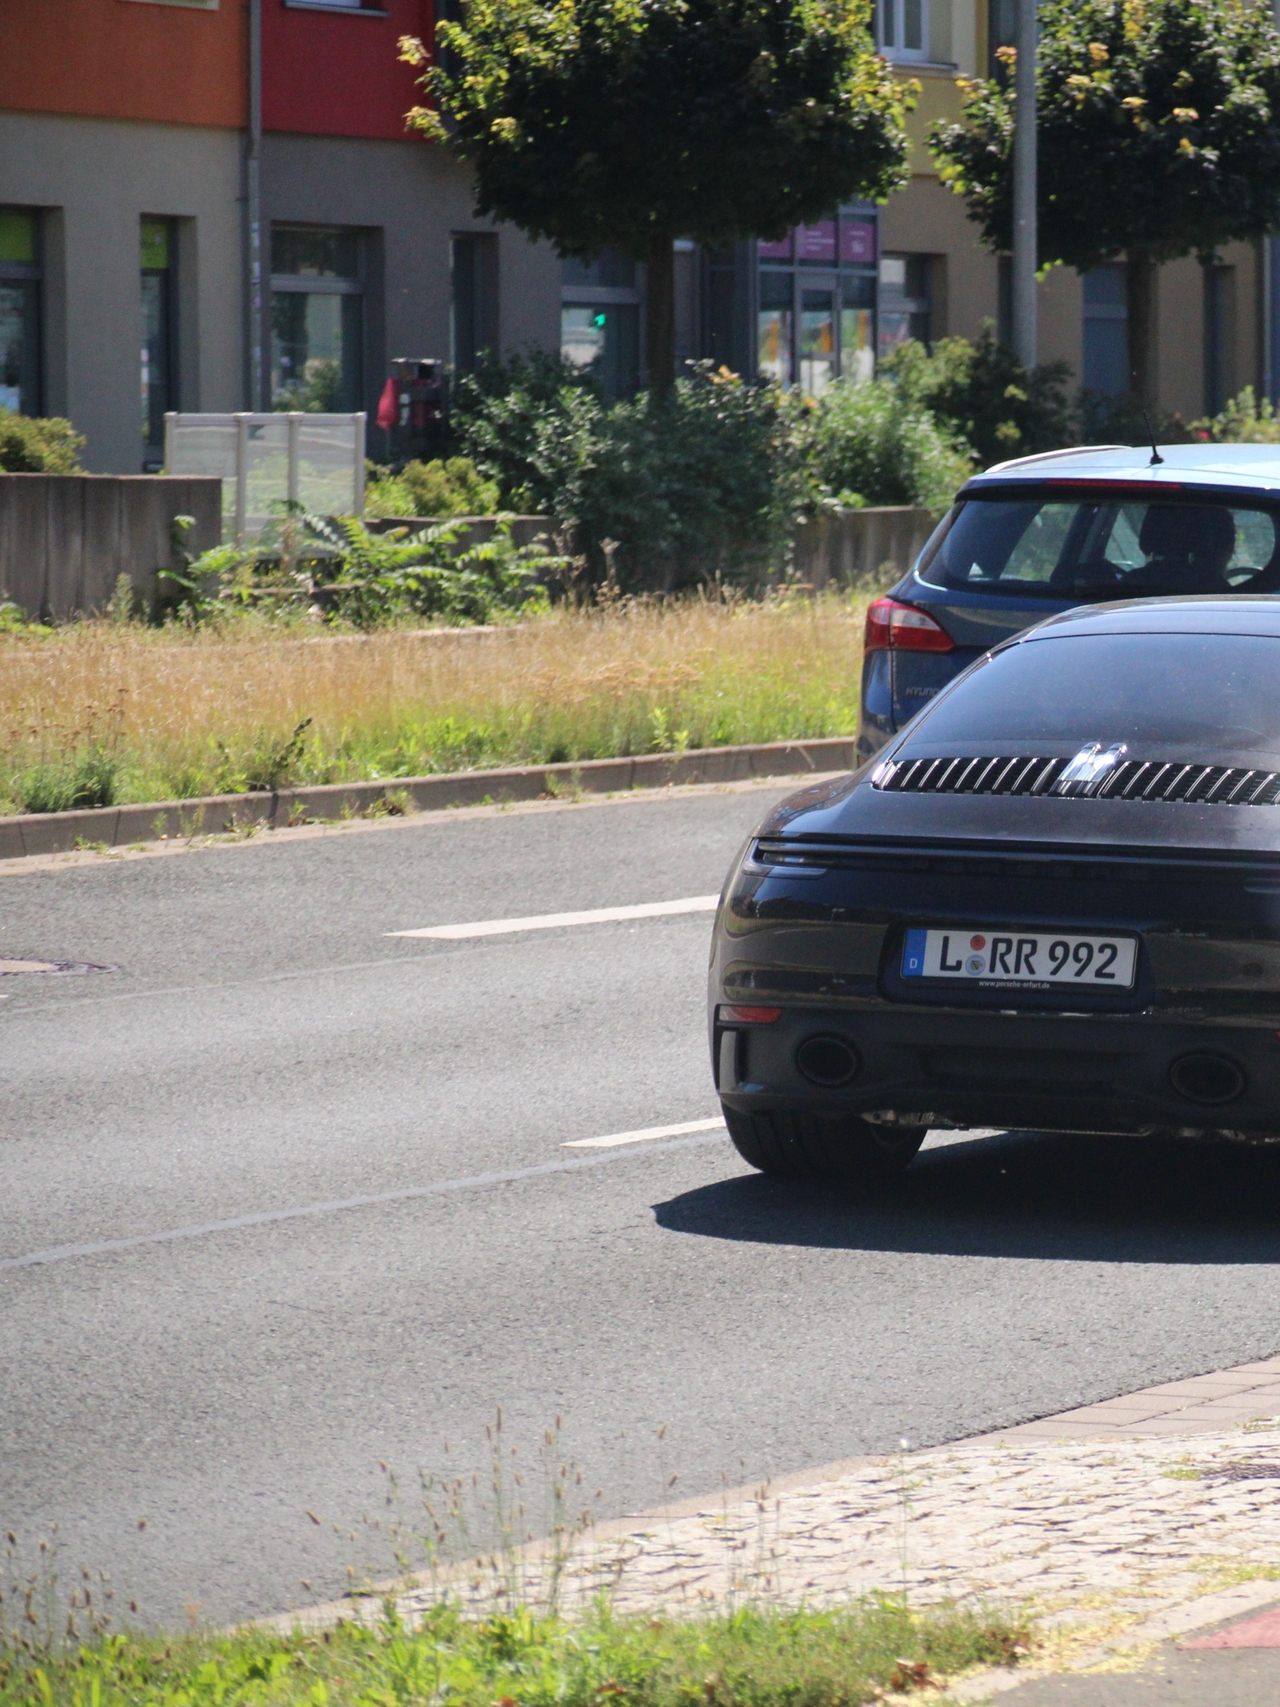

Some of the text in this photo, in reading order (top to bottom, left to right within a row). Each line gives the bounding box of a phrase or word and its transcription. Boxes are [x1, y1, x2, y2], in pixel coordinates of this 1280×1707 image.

[909, 936, 1118, 979] D L RR 992
[979, 980, 1050, 989] www.porsche-erfurt.de
